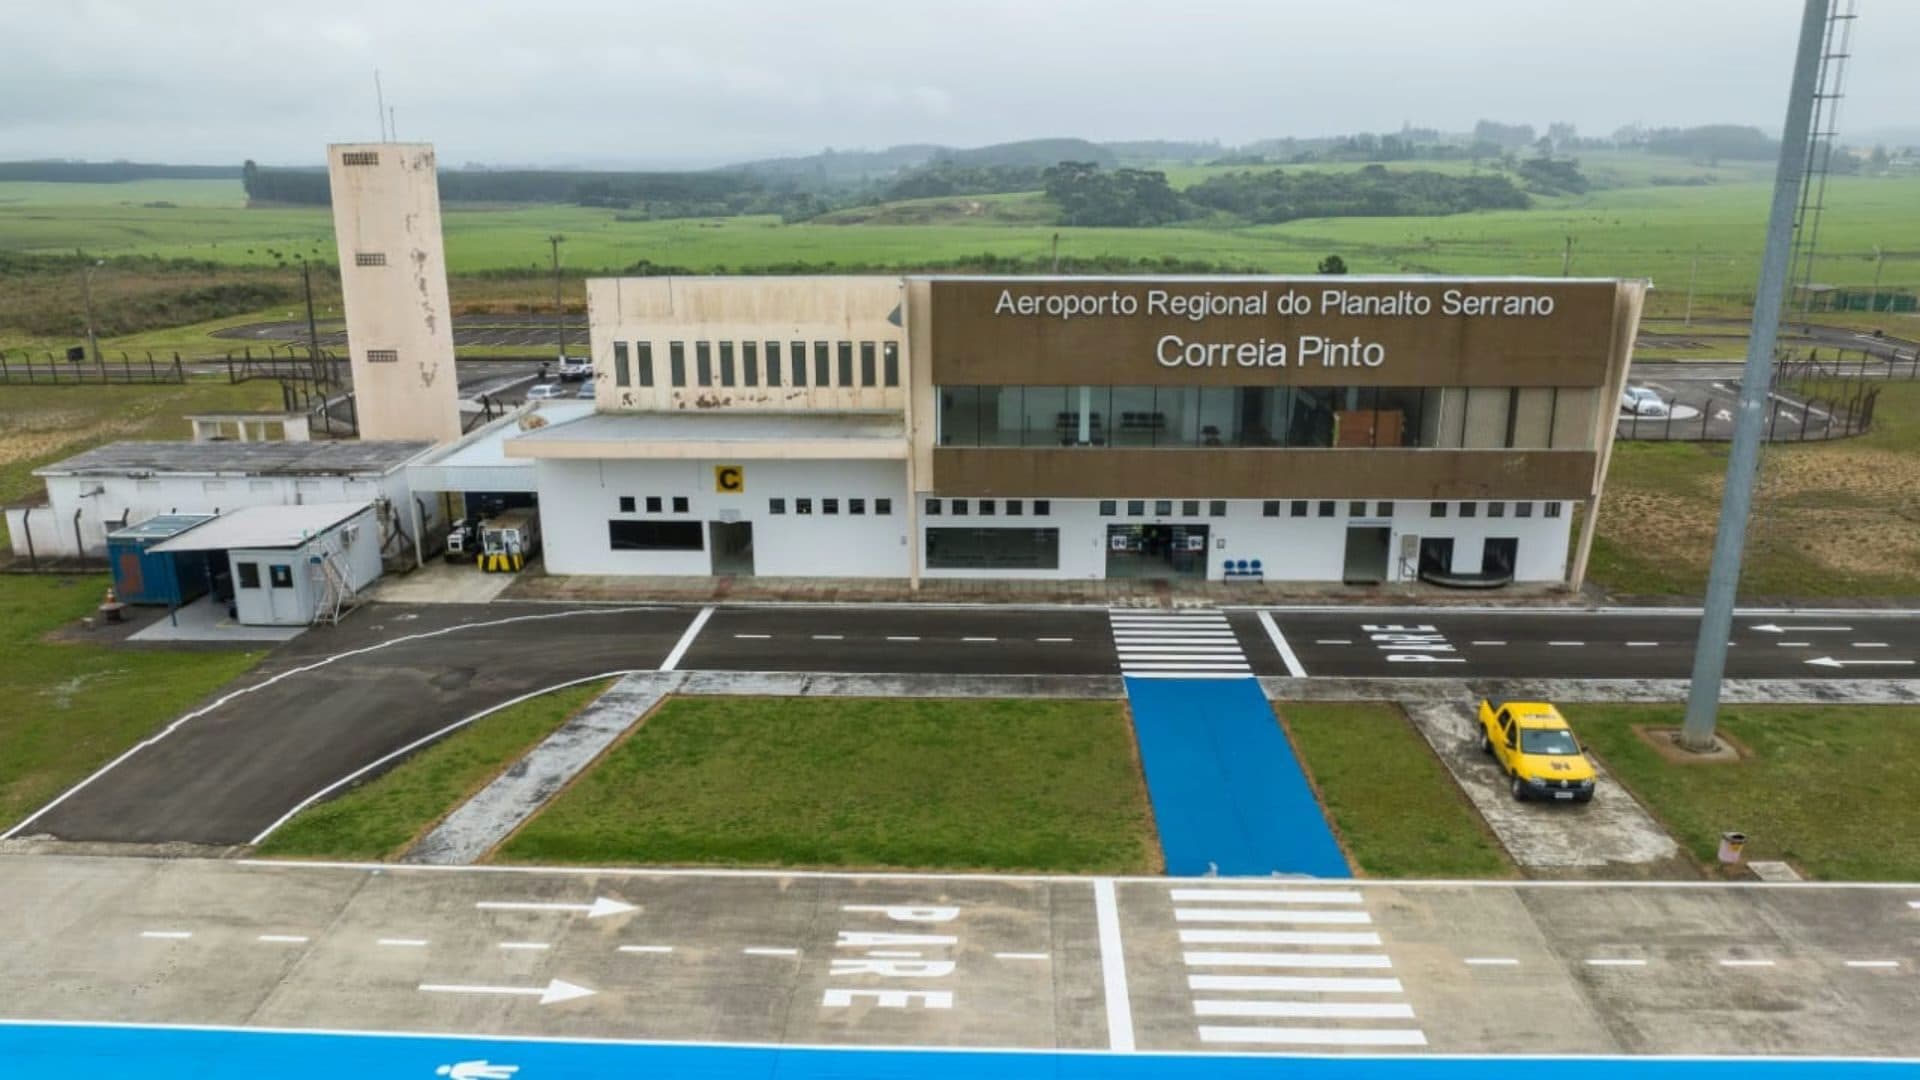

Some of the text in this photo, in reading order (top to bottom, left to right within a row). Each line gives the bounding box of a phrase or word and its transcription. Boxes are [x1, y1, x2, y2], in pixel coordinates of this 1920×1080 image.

[995, 289, 1554, 321] Aeroporto Regional do Planalto Serrano
[1157, 335, 1384, 367] Correia Pinto
[719, 469, 739, 490] C
[822, 905, 960, 1008] PARE
